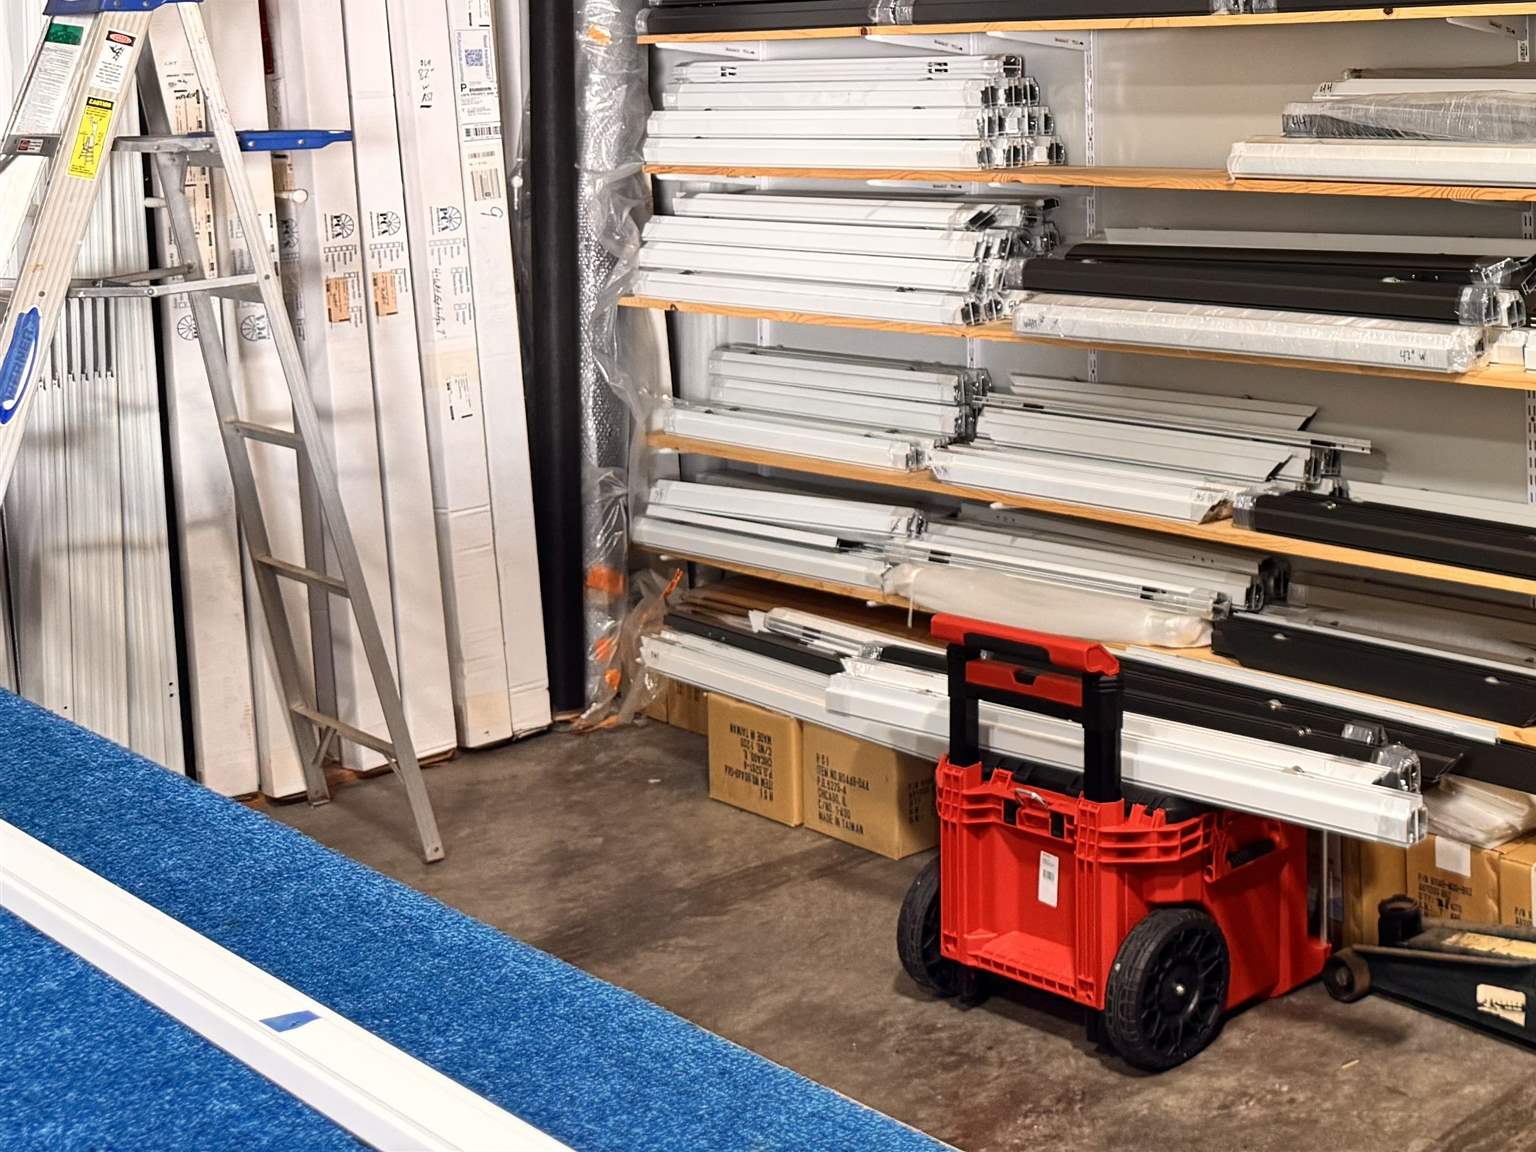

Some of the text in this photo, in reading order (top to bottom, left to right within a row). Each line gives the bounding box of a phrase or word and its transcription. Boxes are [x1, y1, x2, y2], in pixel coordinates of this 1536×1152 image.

[460, 83, 467, 92] P
[333, 215, 343, 238] PCA
[379, 212, 389, 235] PCA
[439, 208, 450, 232] PCA
